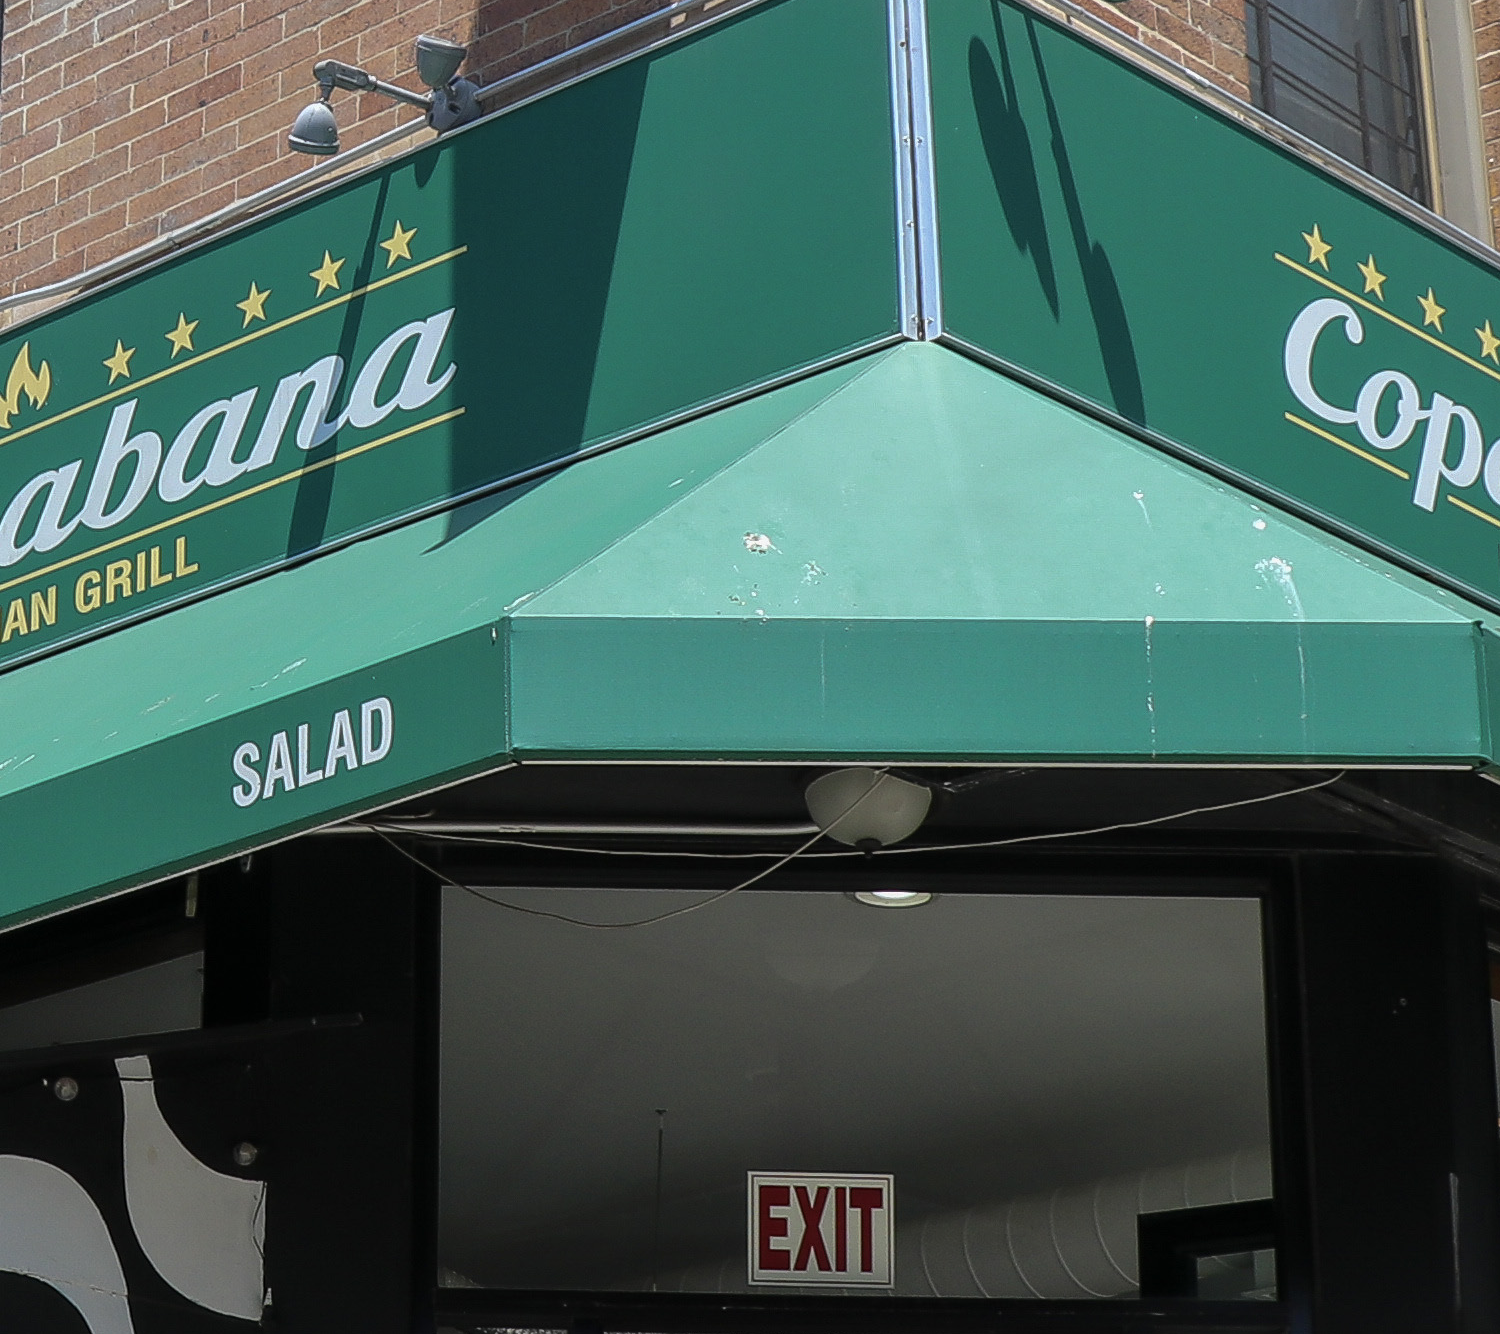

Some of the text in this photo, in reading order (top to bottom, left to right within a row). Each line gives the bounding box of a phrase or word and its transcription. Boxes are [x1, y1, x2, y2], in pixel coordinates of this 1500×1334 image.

[74, 536, 200, 615] GRILL
[232, 696, 394, 808] SALAD
[759, 1185, 883, 1273] EXIT
